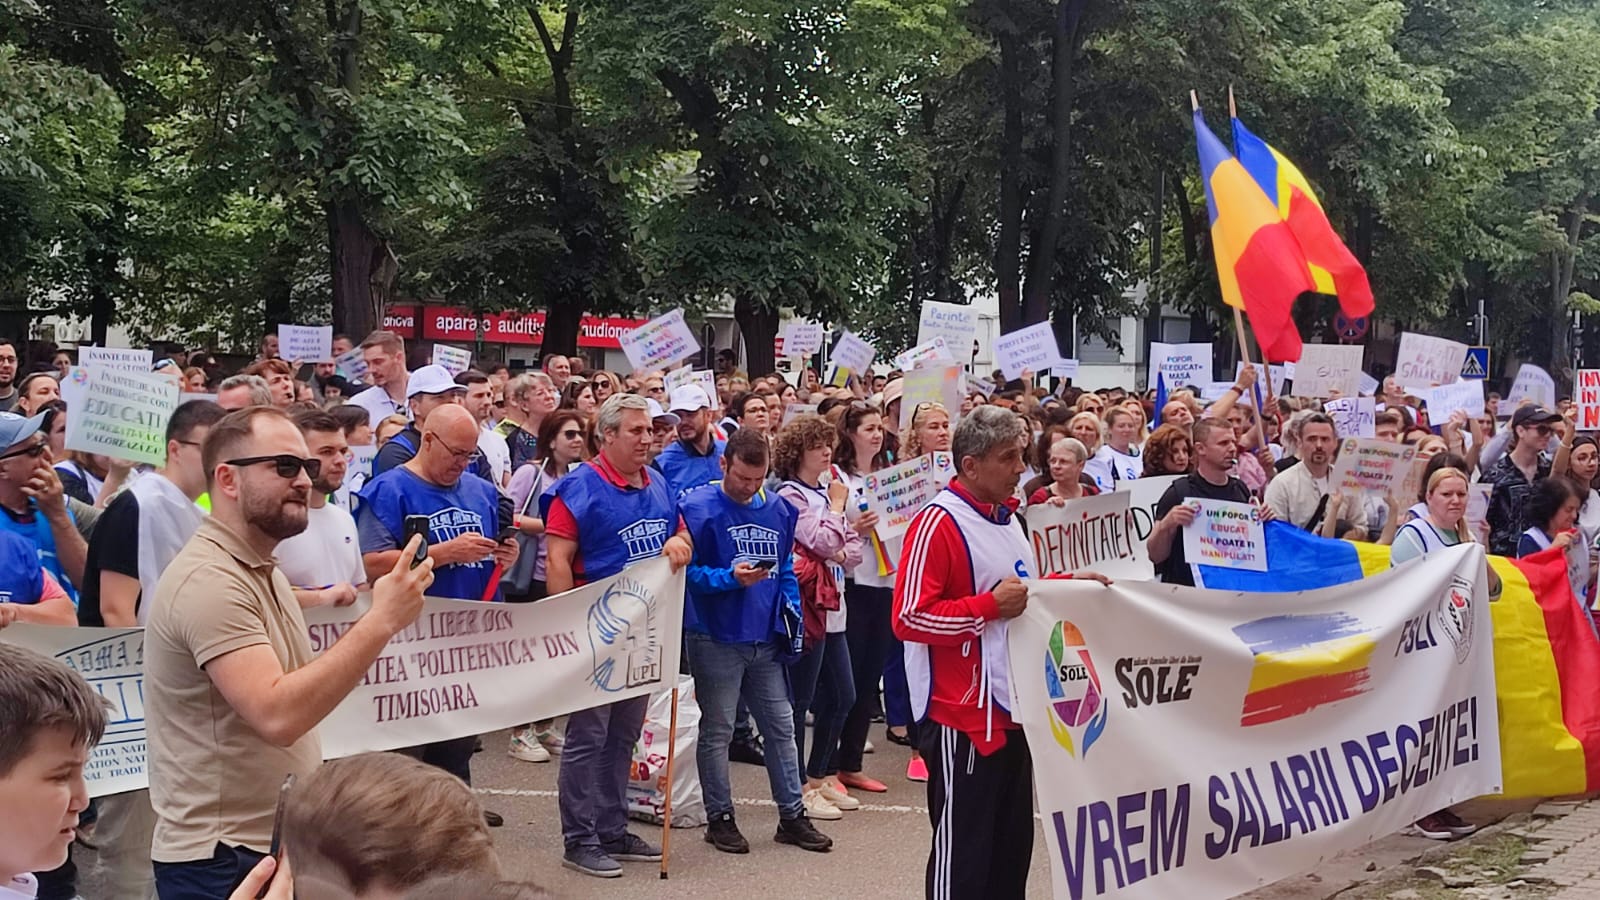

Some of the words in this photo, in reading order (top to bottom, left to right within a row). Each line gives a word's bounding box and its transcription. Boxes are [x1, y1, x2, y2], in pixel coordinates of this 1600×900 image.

[383, 316, 414, 327] onova
[436, 316, 491, 334] aparae
[582, 324, 637, 338] udiono
[998, 330, 1048, 351] PROTESTUL
[1167, 355, 1193, 364] POPOR
[1372, 448, 1400, 459] POPOR
[881, 473, 903, 487] DACĂ
[904, 467, 922, 479] BANI
[1358, 471, 1384, 480] POATE
[877, 493, 890, 503] NU
[892, 486, 907, 498] MAI
[886, 506, 893, 514] O
[1206, 510, 1220, 518] UN
[1222, 511, 1250, 521] POPOR
[1210, 524, 1246, 534] EDUCAT
[1200, 536, 1214, 545] NU
[1216, 538, 1245, 548] POATE
[1247, 541, 1255, 549] FI
[1394, 610, 1438, 658] FSLI
[545, 632, 580, 659] DIN
[632, 663, 657, 681] UPT
[1060, 665, 1088, 683] SOLE
[1115, 657, 1200, 709] SOLE
[373, 682, 479, 722] TIMISOARA
[91, 748, 116, 757] ATIA
[126, 755, 145, 764] NAT
[83, 771, 104, 781] NAL
[1052, 783, 1192, 900] VREM
[1204, 747, 1350, 860] SALARII
[1341, 695, 1480, 813] DECENTE!
